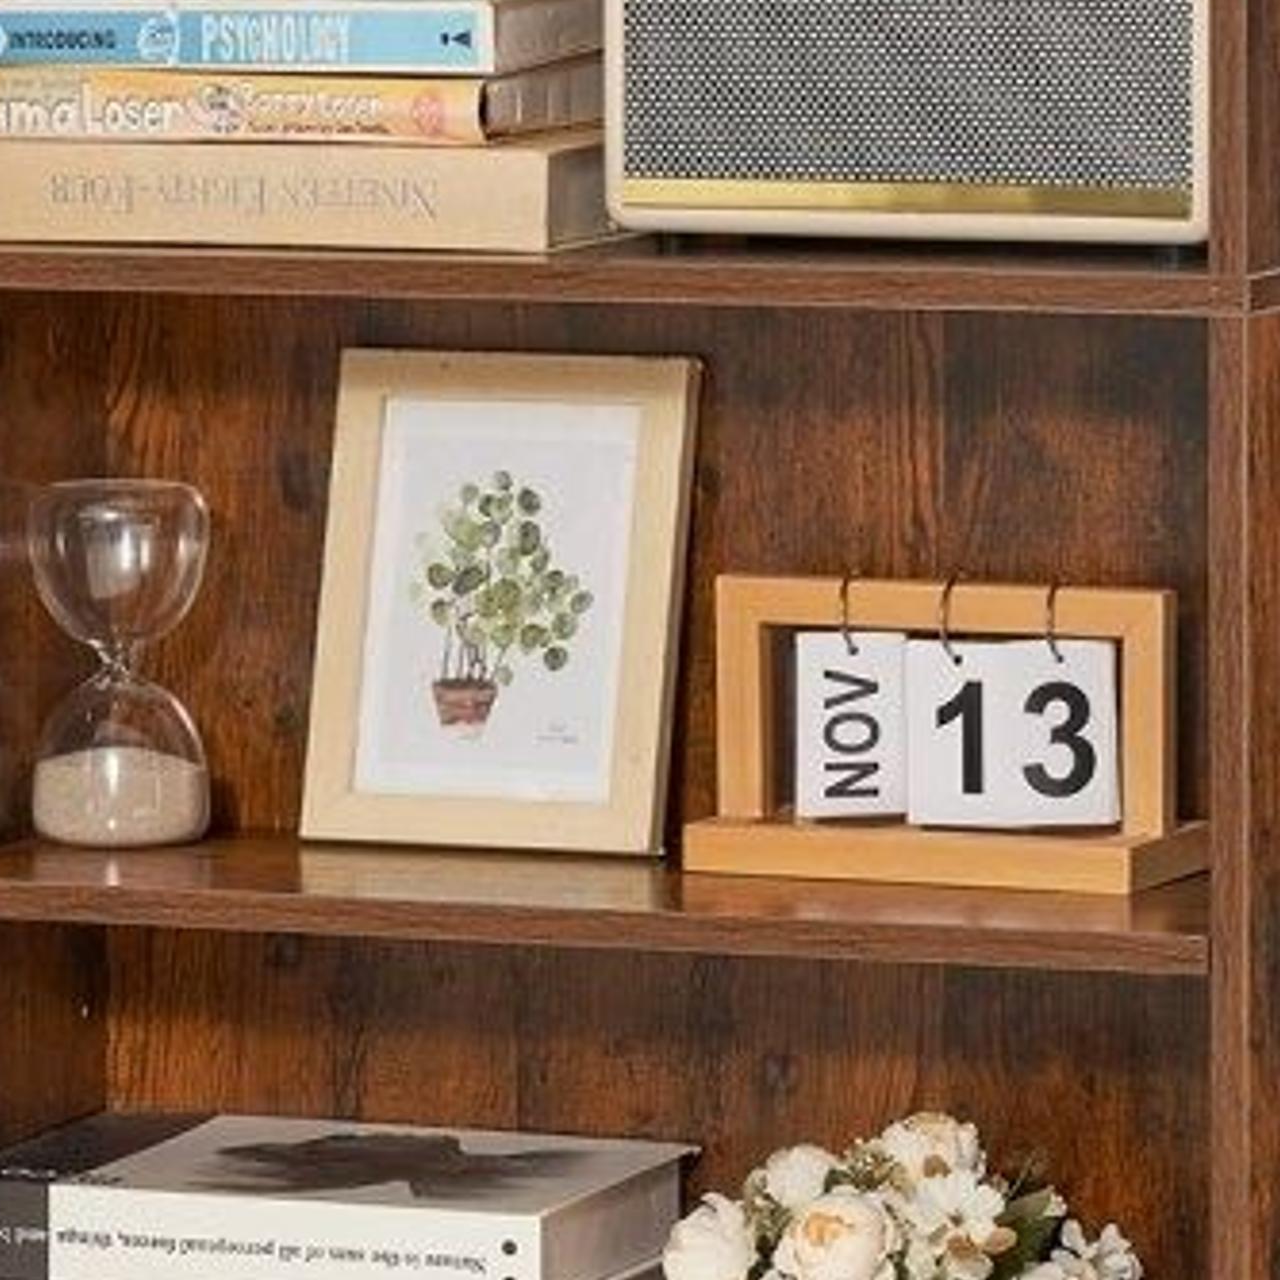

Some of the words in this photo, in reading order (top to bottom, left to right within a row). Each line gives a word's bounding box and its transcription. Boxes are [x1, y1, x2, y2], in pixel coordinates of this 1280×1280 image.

[8, 27, 117, 50] INTRODUCING
[200, 13, 350, 63] PSYCHOLOGY
[81, 80, 186, 134] Loser
[823, 670, 880, 798] NOV
[935, 680, 1098, 798] 13
[56, 1228, 112, 1248] things
[278, 1244, 302, 1261] all
[305, 1245, 324, 1262] of
[329, 1246, 365, 1262] sum
[371, 1250, 400, 1267] the
[424, 1252, 487, 1274] Nature
